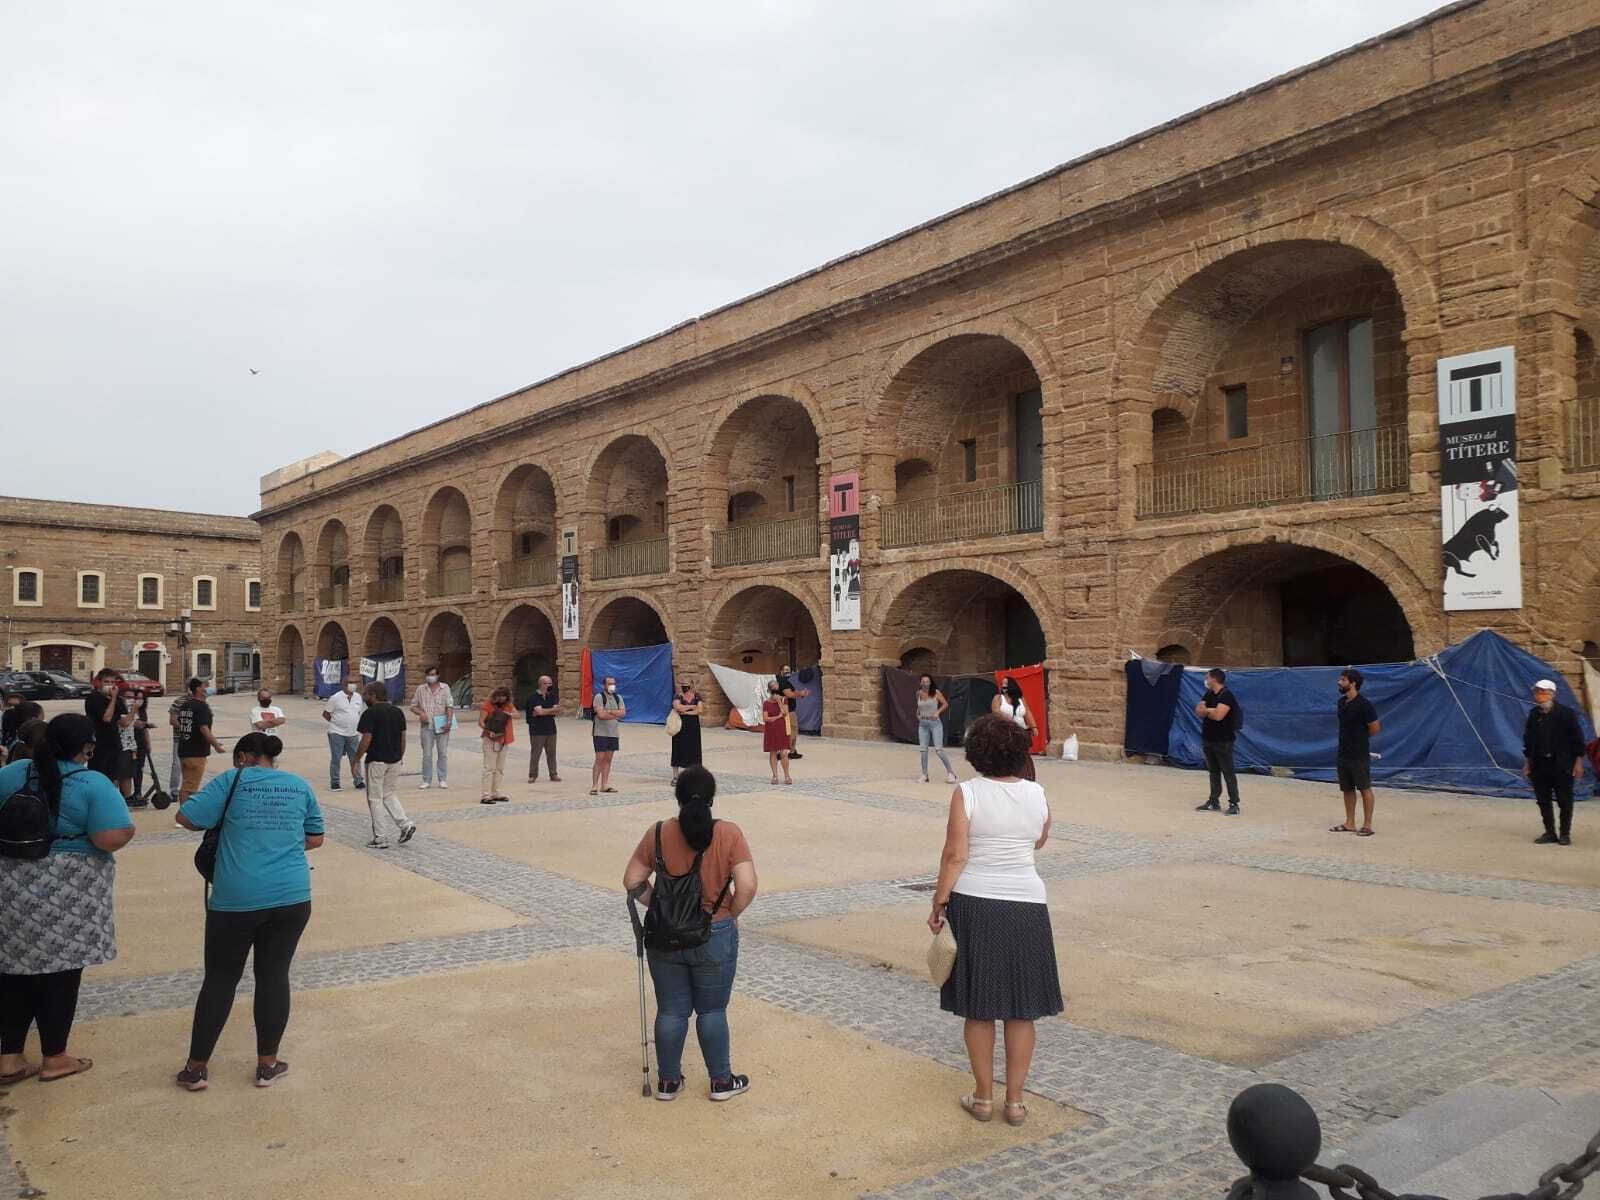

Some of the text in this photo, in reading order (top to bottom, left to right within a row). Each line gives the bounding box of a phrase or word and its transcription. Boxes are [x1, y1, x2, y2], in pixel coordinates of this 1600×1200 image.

[1446, 431, 1497, 444] MUSEO del
[1446, 441, 1510, 460] TÍTERE
